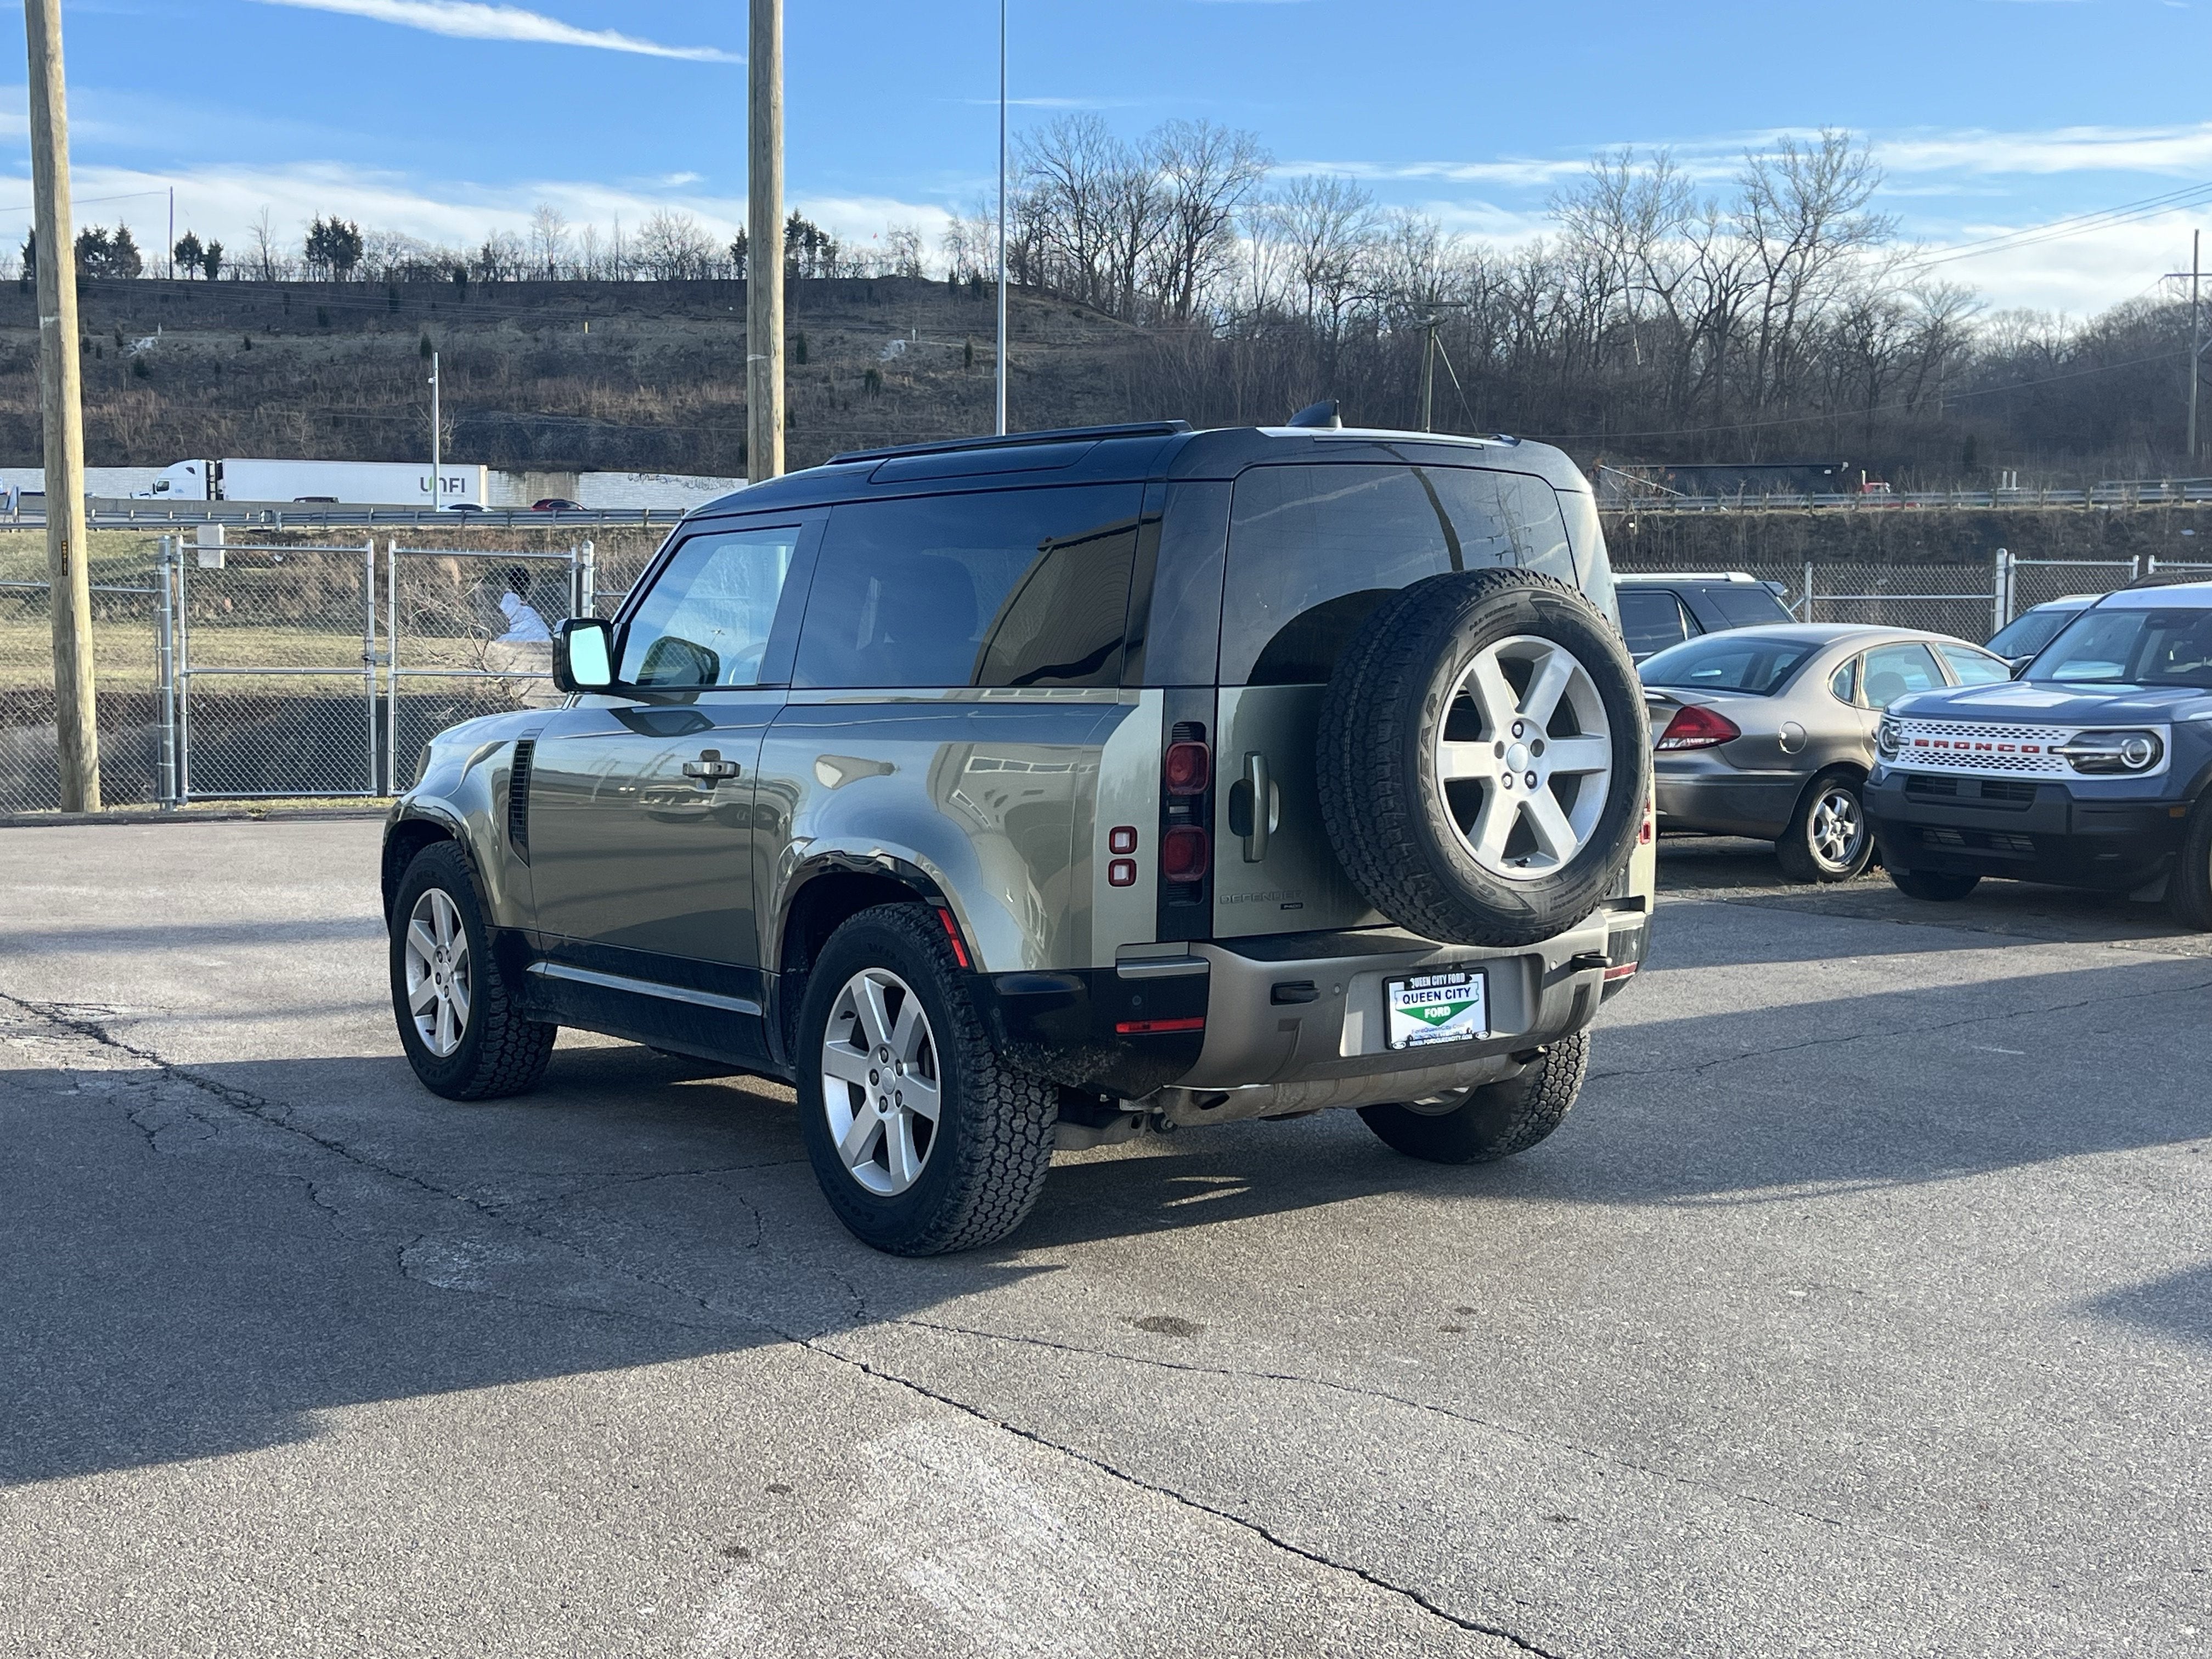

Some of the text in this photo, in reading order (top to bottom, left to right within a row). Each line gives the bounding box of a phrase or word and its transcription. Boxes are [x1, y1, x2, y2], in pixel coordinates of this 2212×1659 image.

[1914, 738, 2040, 754] BRONCO
[1420, 692, 1497, 899] GOODYEAR
[1220, 890, 1302, 904] DEFENDER
[1431, 974, 1447, 986] CITY
[1448, 973, 1465, 984] FORD
[1402, 988, 1471, 1005] QUEEN CITY
[1424, 1006, 1452, 1019] FORD
